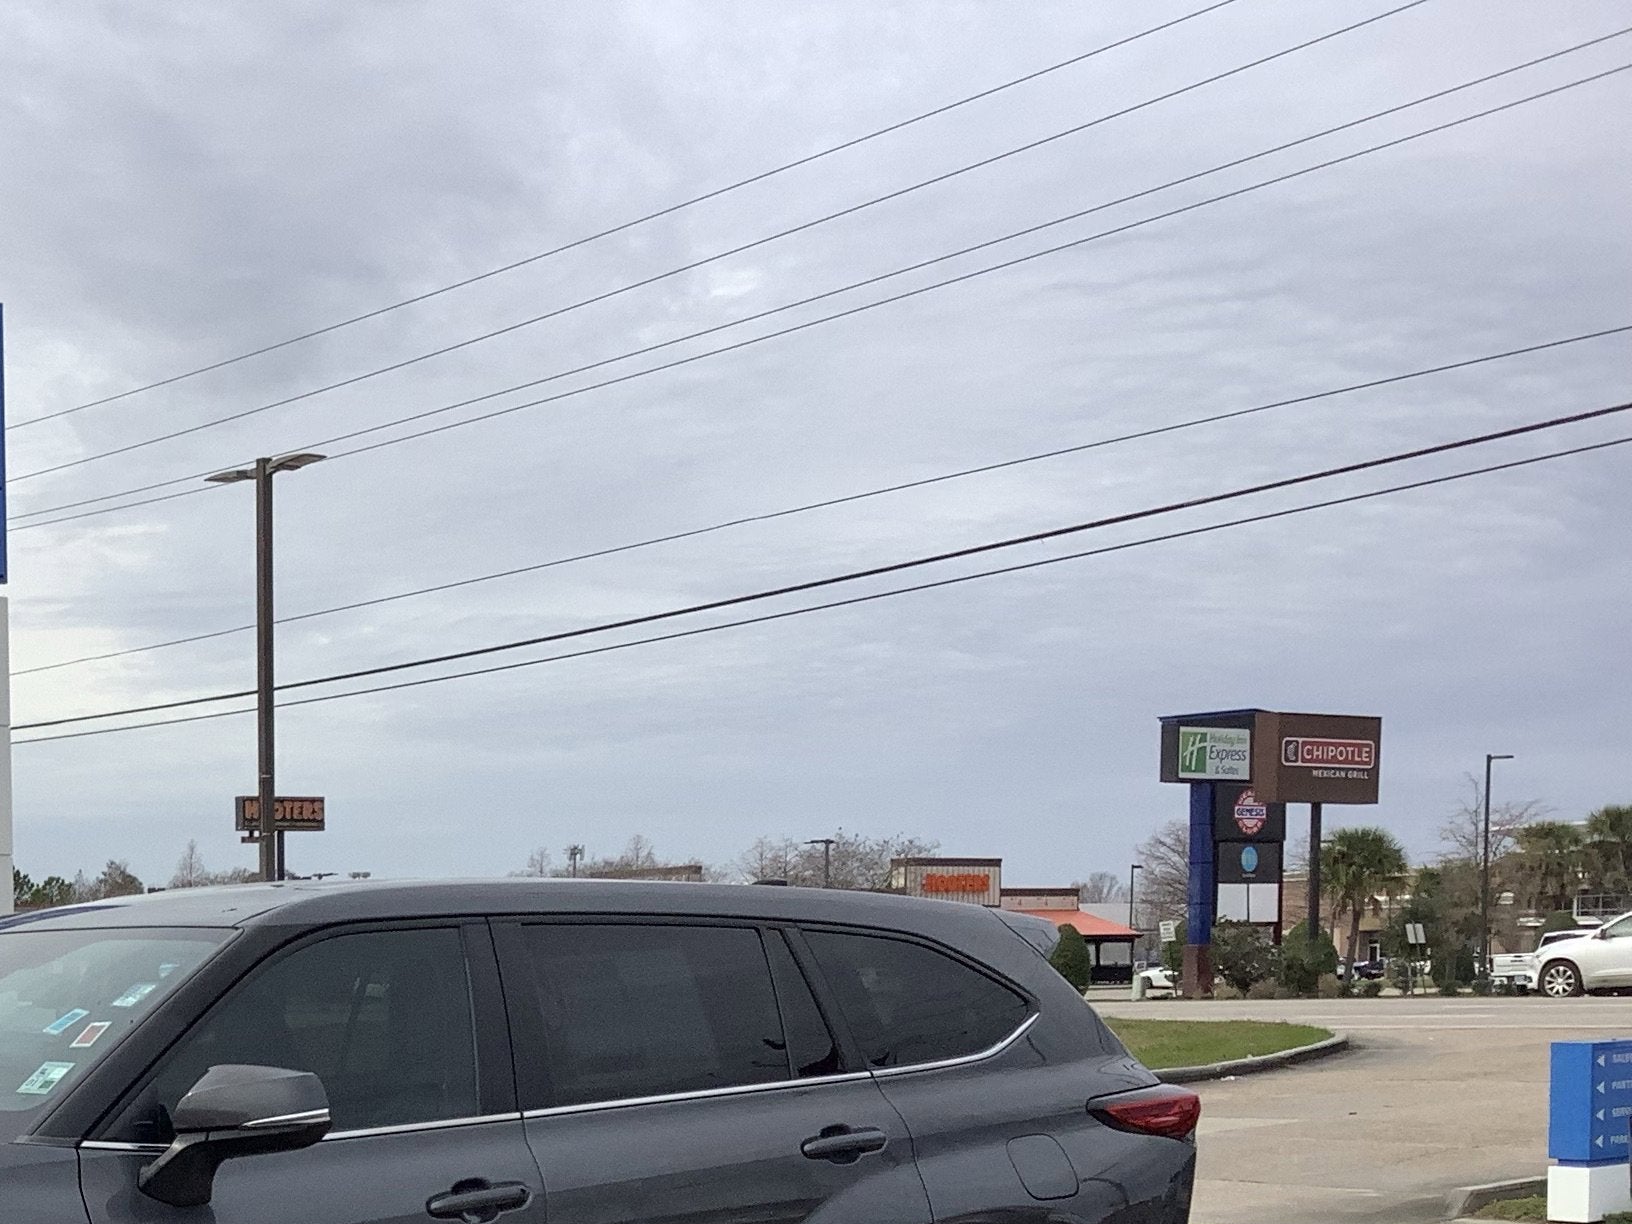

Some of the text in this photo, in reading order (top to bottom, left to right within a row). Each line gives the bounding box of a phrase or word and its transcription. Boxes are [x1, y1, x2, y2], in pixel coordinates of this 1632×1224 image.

[1209, 744, 1247, 764] Express
[1303, 745, 1370, 762] CHIPOTLE
[244, 800, 323, 820] HOTERS
